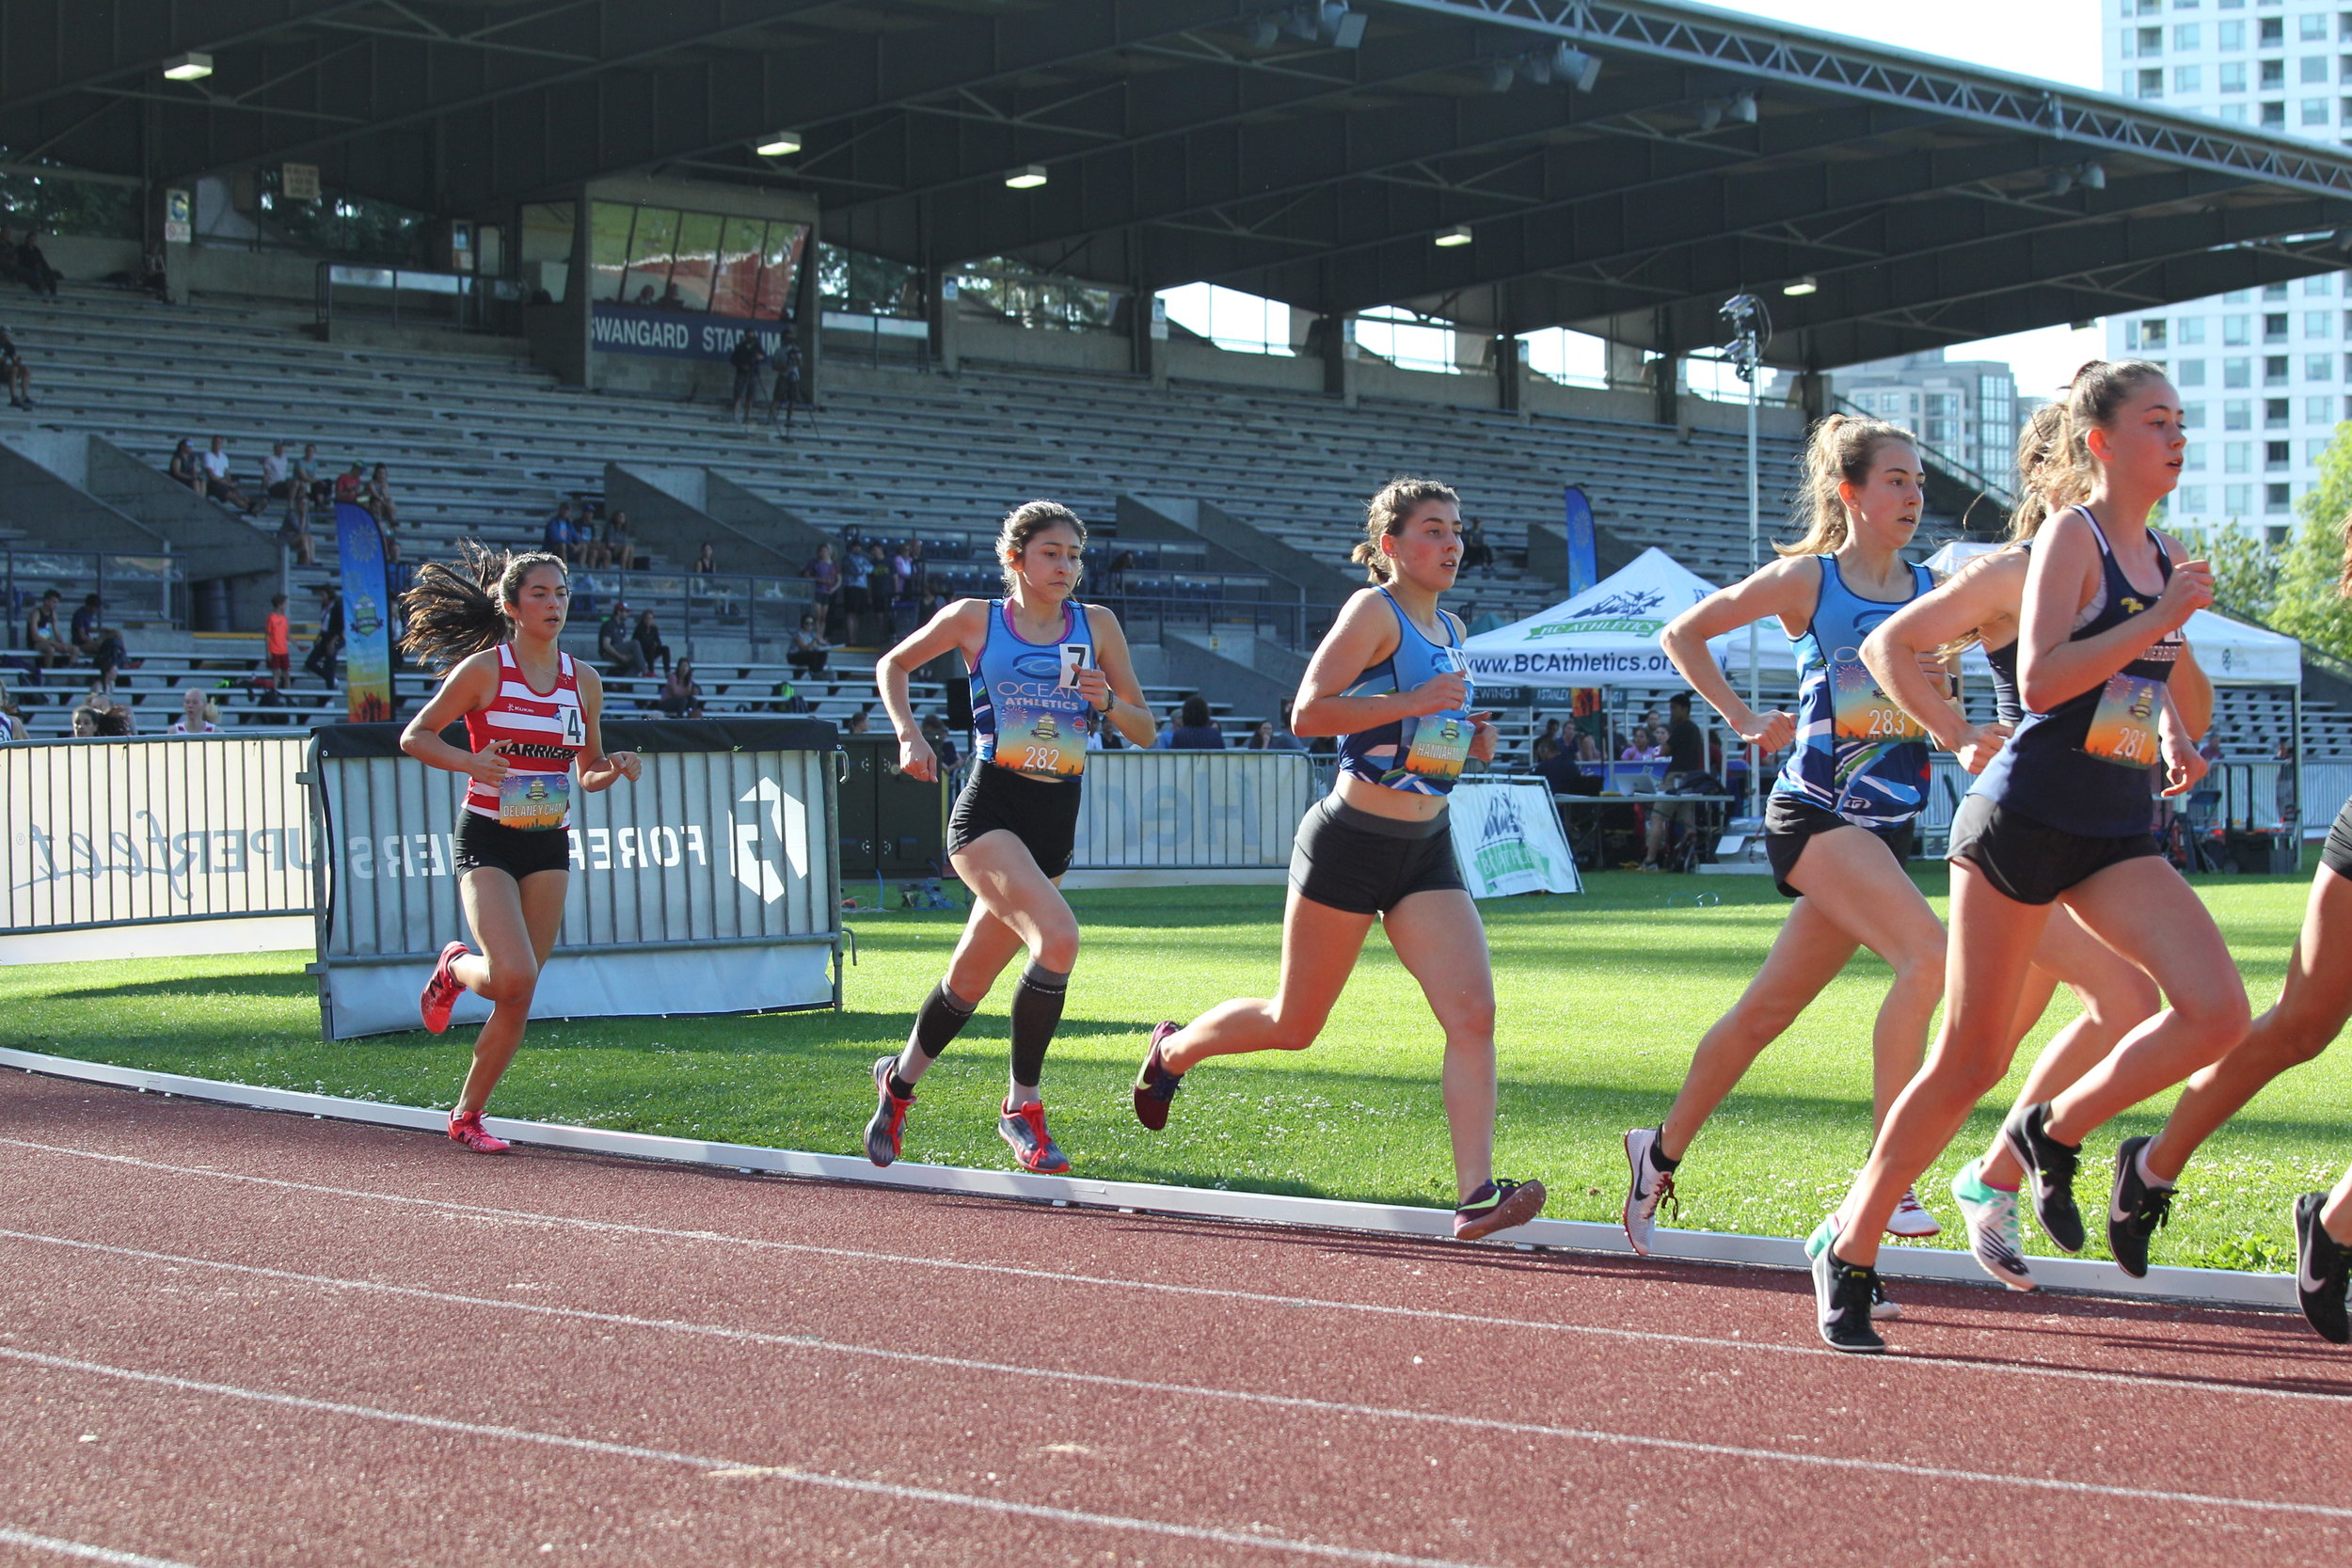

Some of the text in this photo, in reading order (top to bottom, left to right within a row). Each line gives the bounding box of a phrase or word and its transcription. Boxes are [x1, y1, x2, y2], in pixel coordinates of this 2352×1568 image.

[703, 325, 781, 356] STADM
[1539, 620, 1658, 636] BC ATHLETICS
[1068, 647, 1086, 686] 7
[997, 681, 1084, 700] OCEAN
[1473, 688, 1512, 700] EWING
[1005, 698, 1079, 710] ATHLETICS
[567, 709, 581, 744] 4
[1868, 709, 1905, 736] 283
[2113, 727, 2148, 759] 281
[1024, 746, 1060, 770] 282
[503, 804, 544, 817] DELANEY
